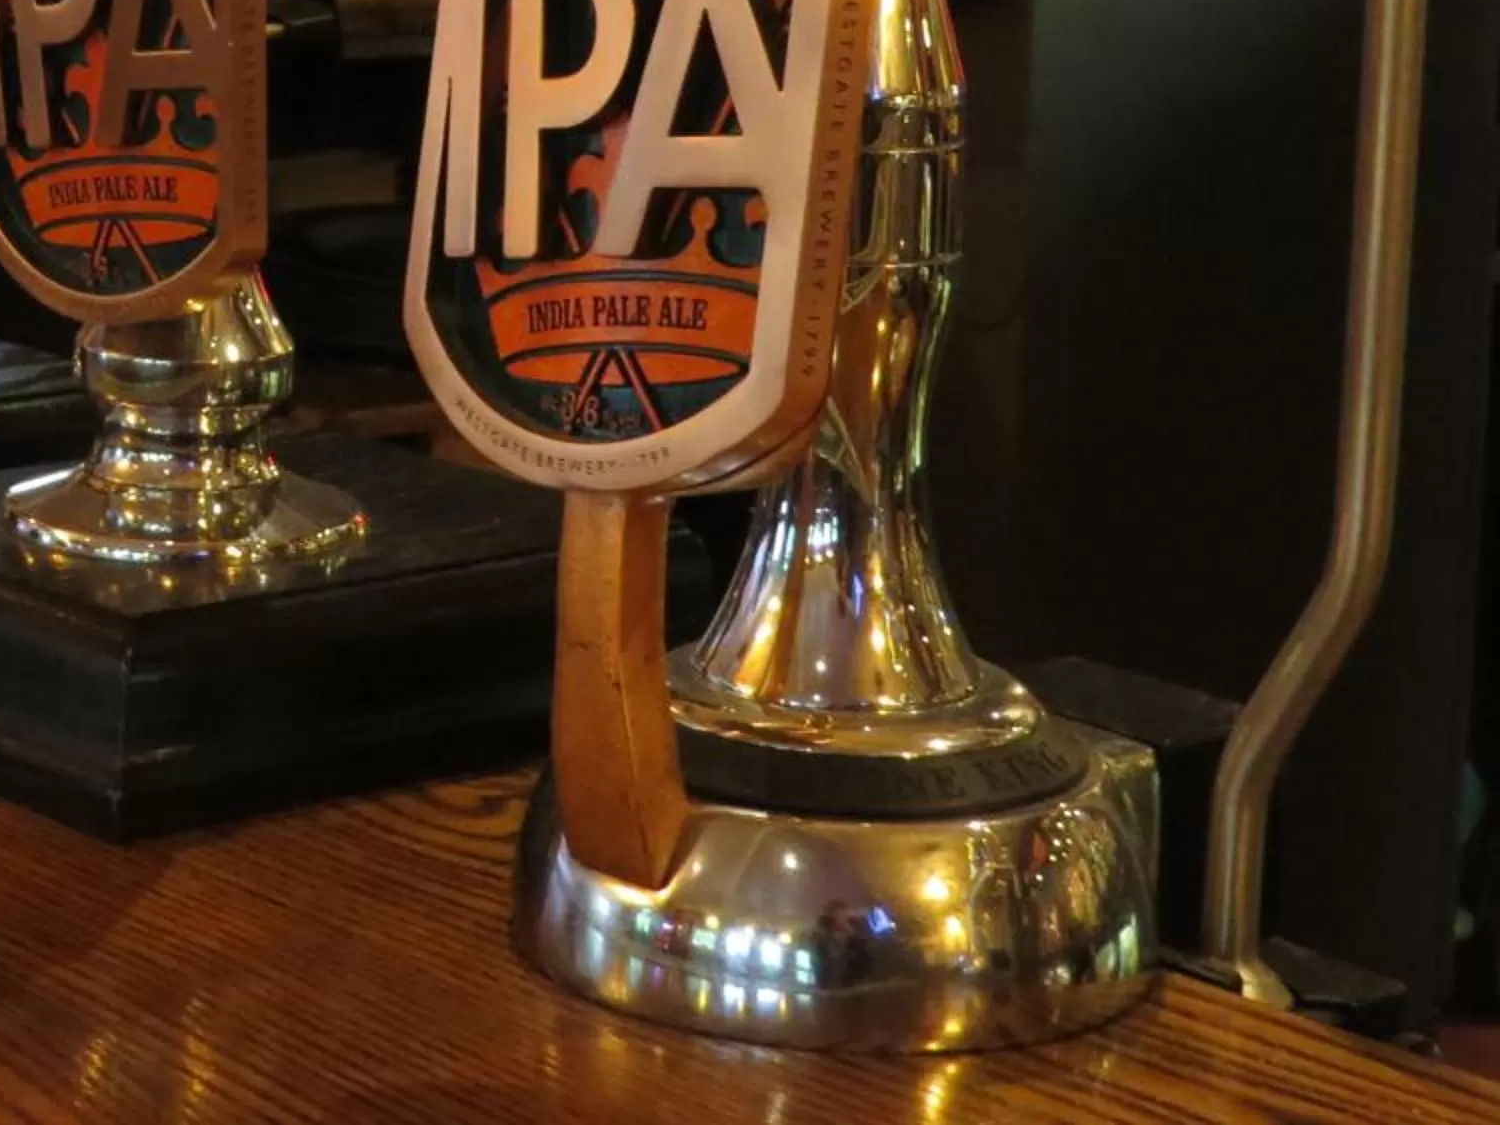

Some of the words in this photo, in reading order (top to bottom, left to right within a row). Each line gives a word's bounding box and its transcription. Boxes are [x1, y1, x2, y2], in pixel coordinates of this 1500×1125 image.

[49, 181, 90, 209] INDIA
[94, 176, 138, 202] PALE
[143, 177, 178, 203] ALE
[527, 296, 584, 334] INDIA
[592, 294, 652, 330] PALE
[657, 296, 708, 331] ALE
